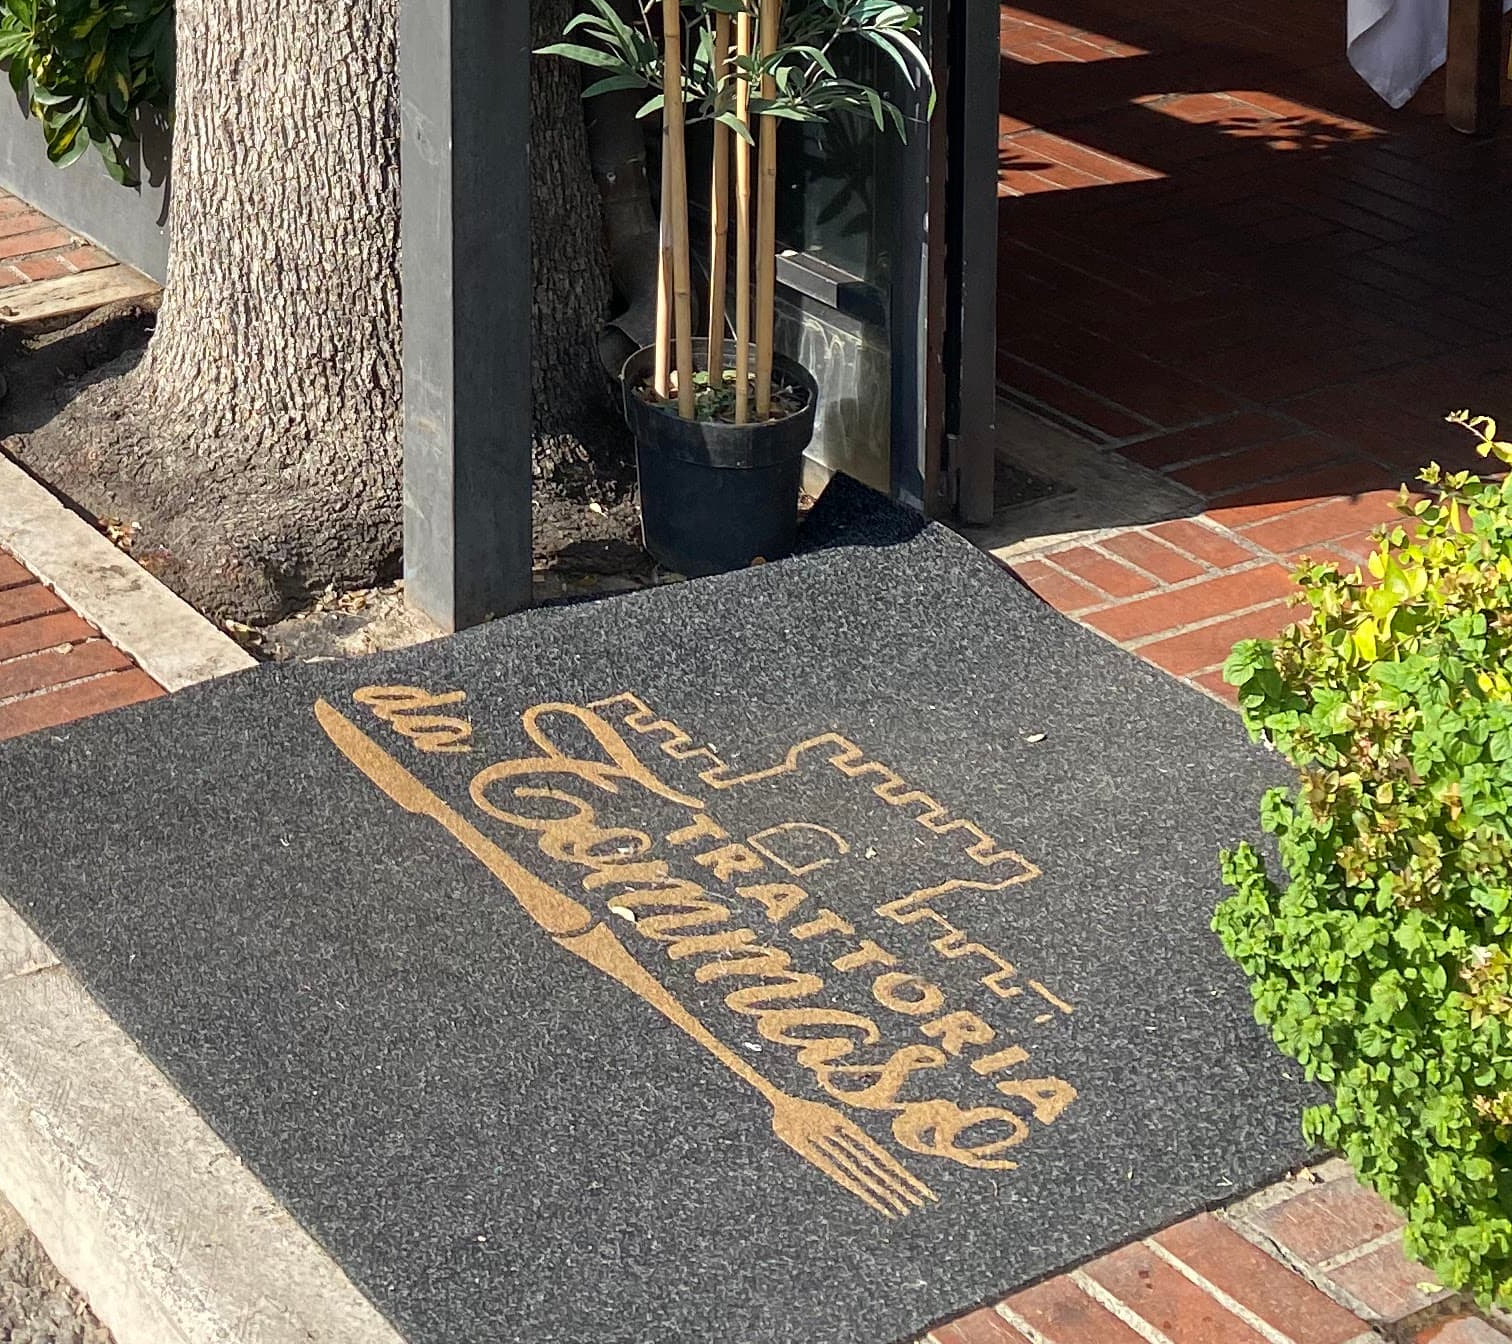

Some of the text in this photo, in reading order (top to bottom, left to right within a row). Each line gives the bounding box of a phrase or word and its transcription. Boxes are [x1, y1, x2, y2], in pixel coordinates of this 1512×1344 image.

[352, 684, 1031, 1172] da Tommaso
[667, 813, 1078, 1125] TRATTORIA
